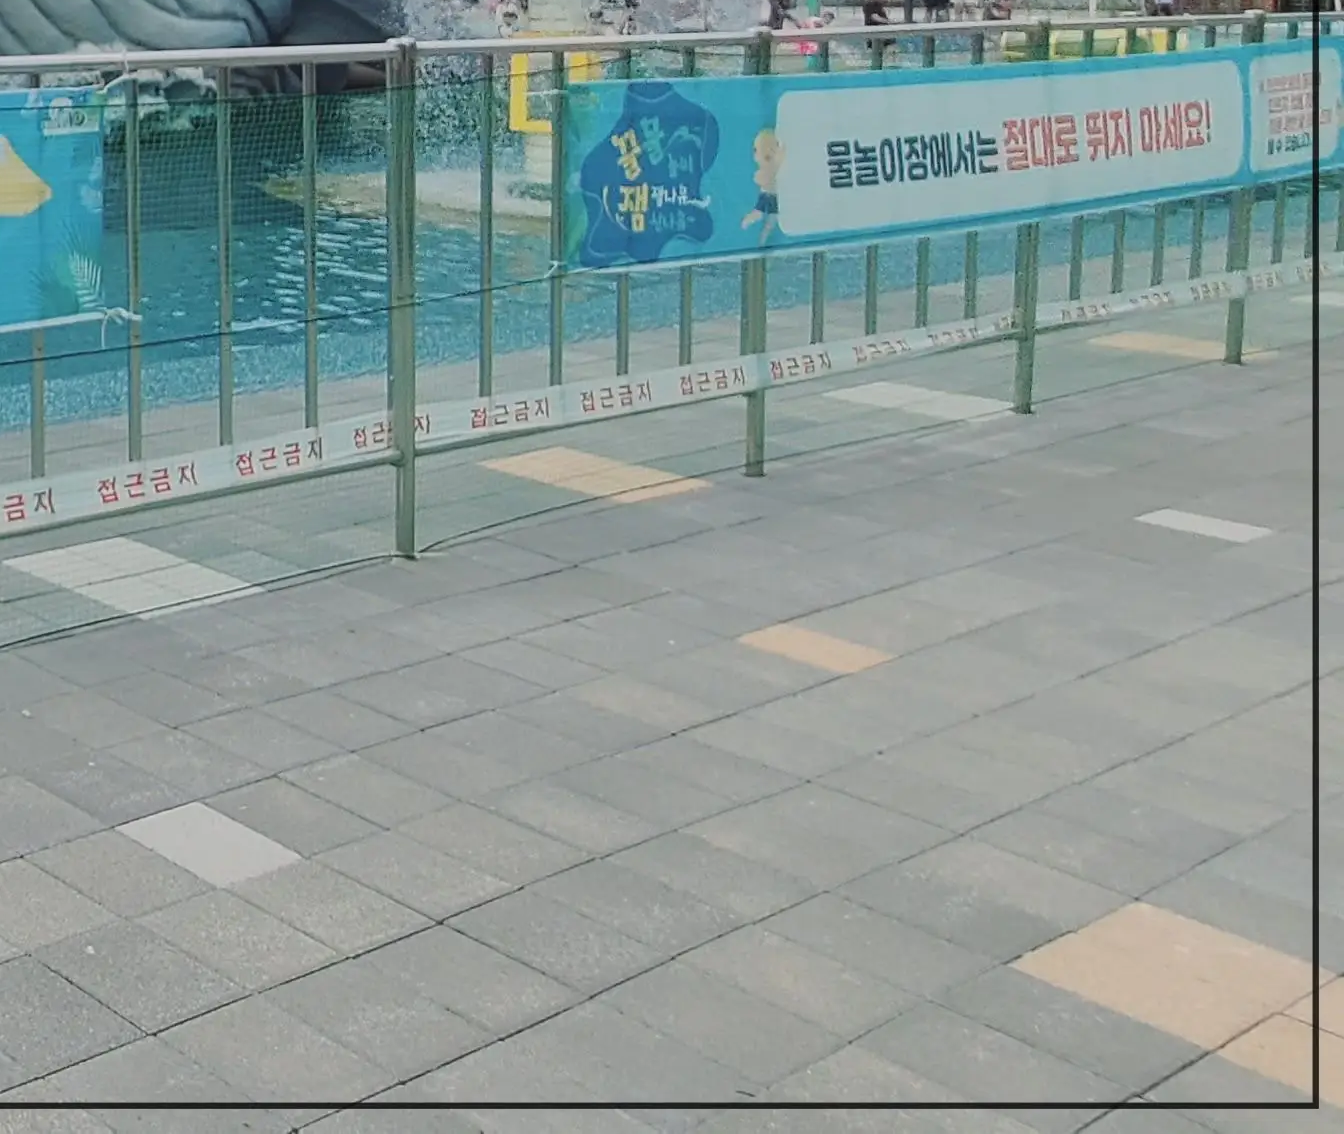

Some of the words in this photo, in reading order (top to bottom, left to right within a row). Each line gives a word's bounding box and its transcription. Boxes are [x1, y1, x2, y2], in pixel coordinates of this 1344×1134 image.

[825, 129, 999, 189] 물놀이장에서는
[1002, 113, 1080, 172] 절대로
[1085, 106, 1133, 163] 뛰지
[1139, 98, 1212, 154] 마세요!
[97, 461, 198, 504] 접근금지
[235, 436, 323, 477] 접근금지
[354, 413, 430, 449] 접근지
[470, 395, 551, 429] 접근금지
[579, 378, 653, 412] 접근금지
[679, 365, 745, 397] 접근금지
